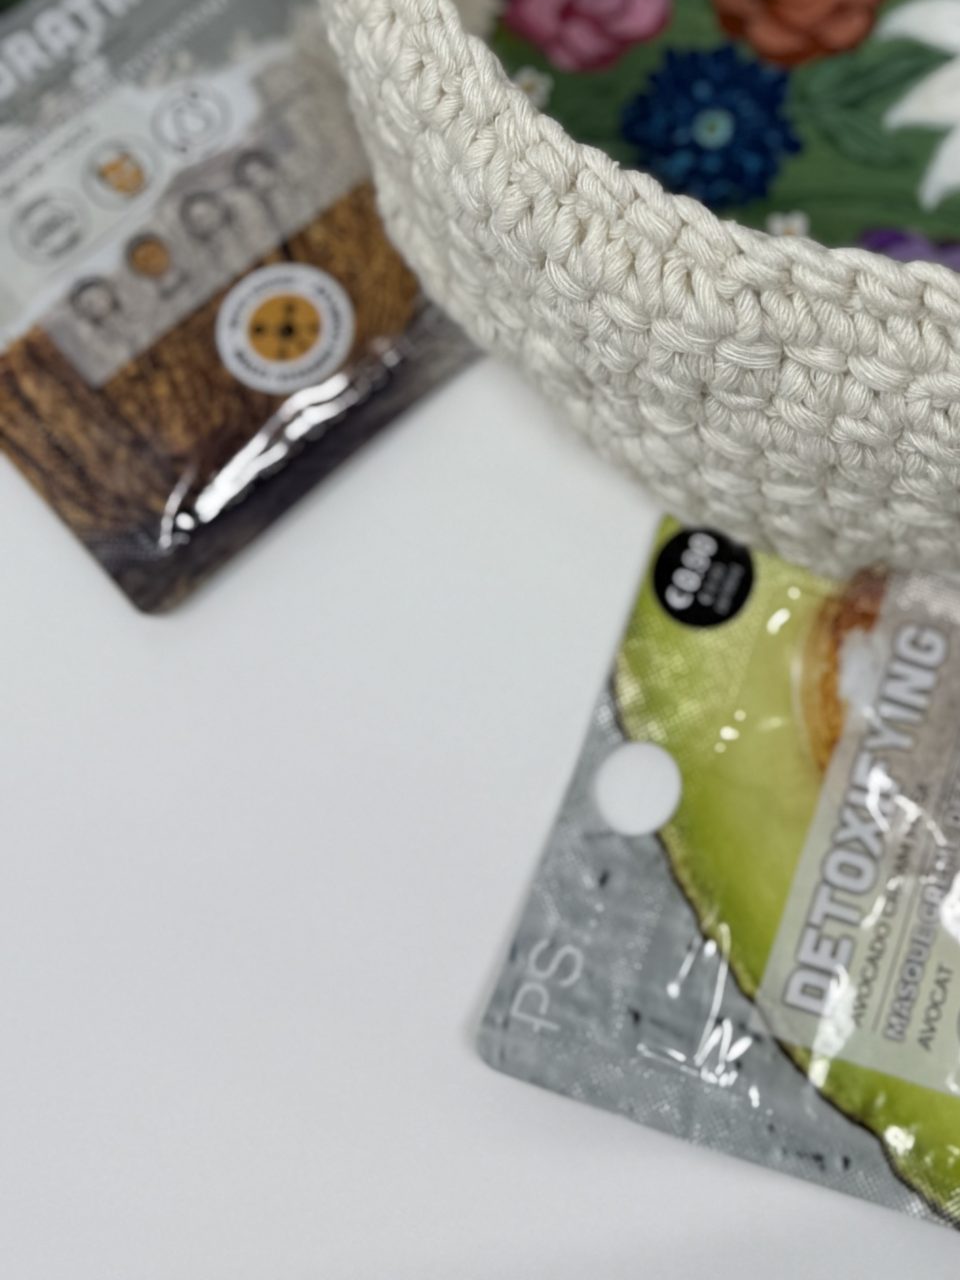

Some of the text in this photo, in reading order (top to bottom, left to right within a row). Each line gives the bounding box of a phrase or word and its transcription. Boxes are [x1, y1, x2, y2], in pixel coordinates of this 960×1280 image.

[783, 624, 949, 1018] DETOXIFYING
[852, 921, 891, 1030] AVOCADO
[884, 926, 937, 1042] MASQUE
[917, 963, 953, 1051] AVOCAT
